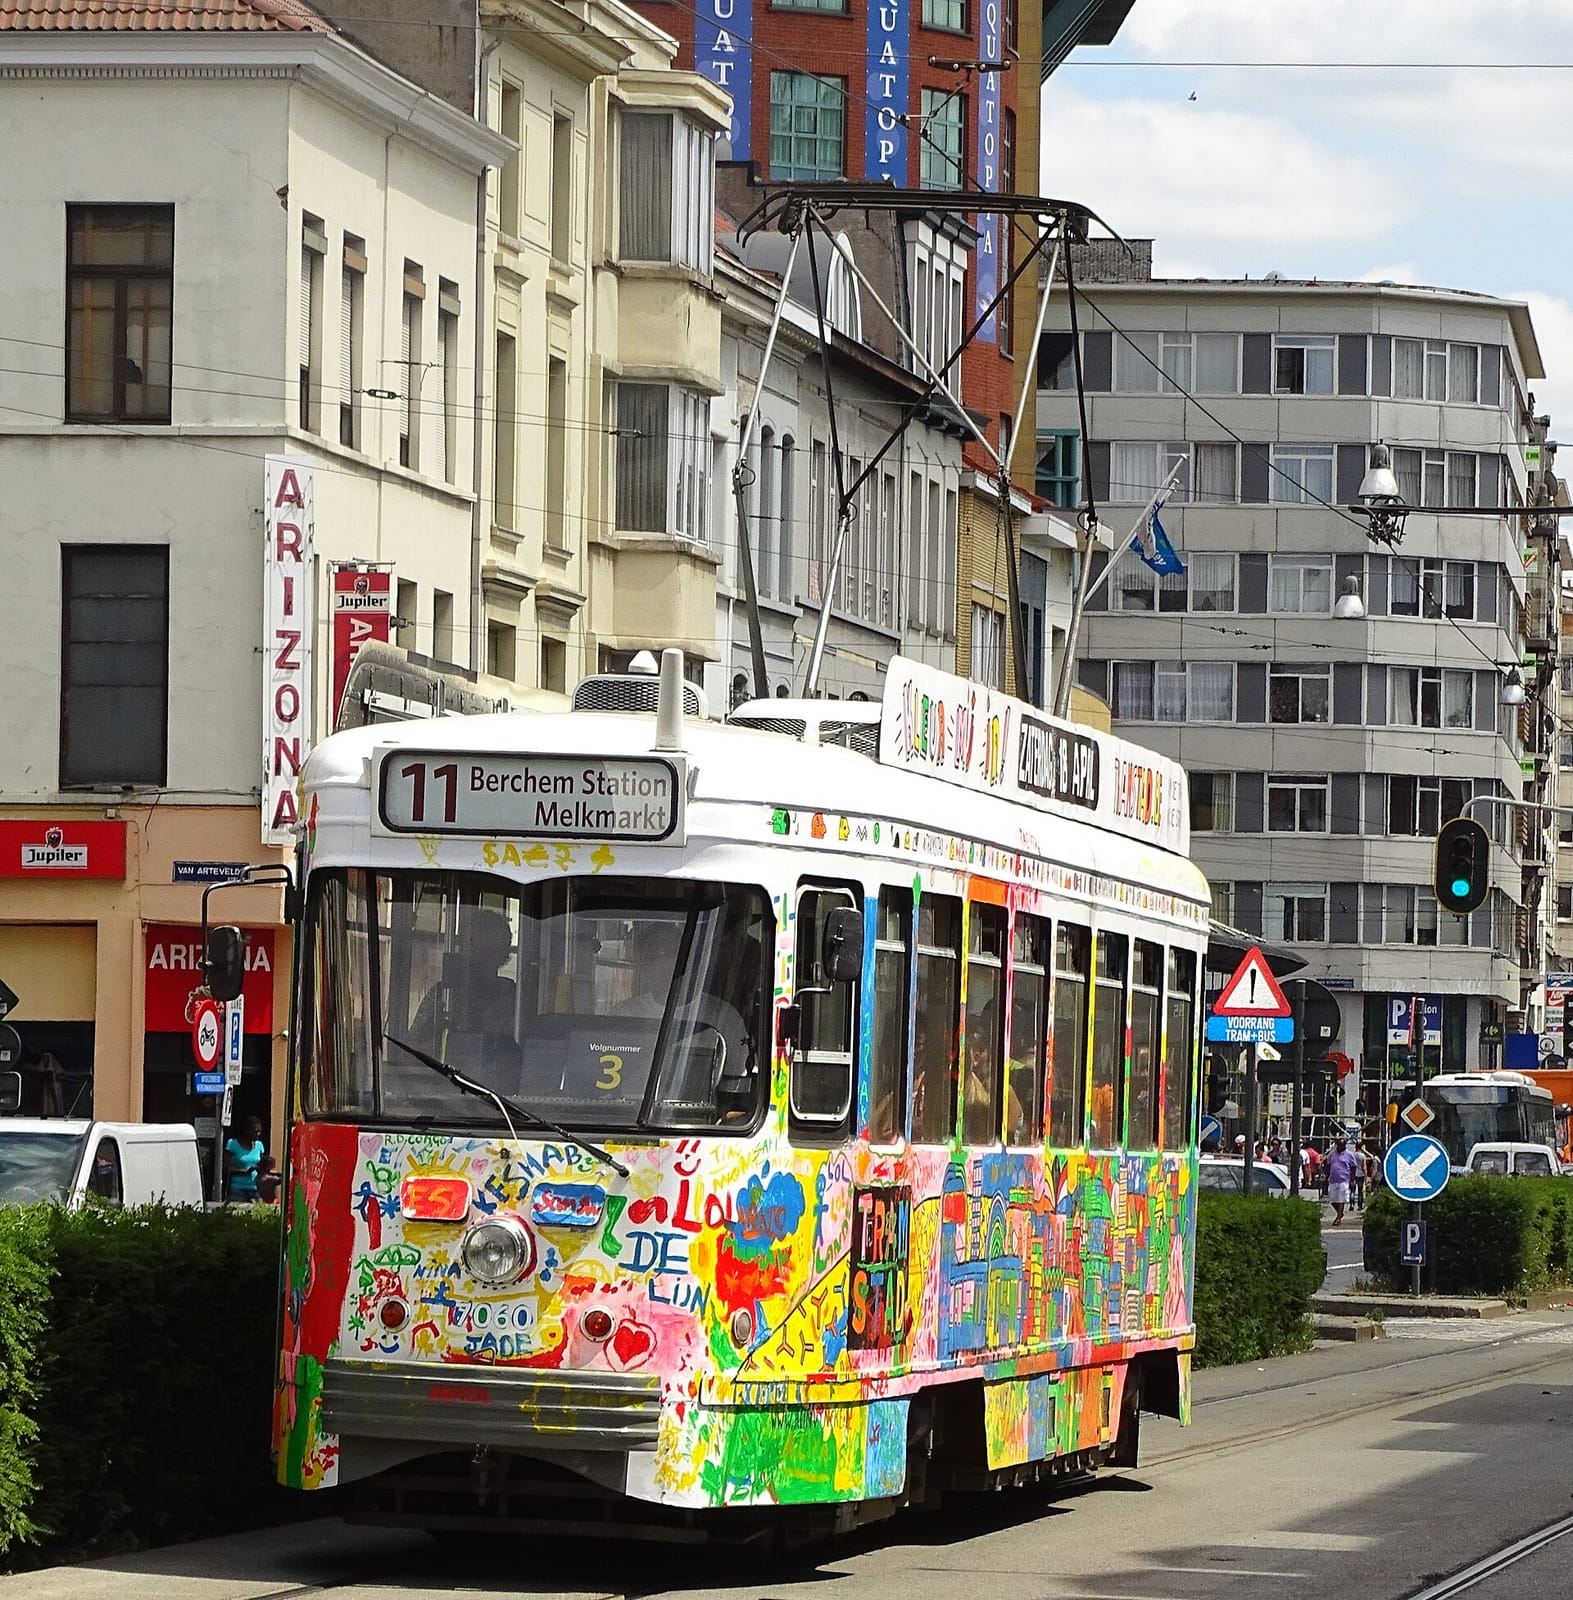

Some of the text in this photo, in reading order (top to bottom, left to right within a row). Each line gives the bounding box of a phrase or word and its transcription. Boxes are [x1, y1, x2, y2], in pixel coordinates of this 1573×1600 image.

[336, 594, 387, 609] Jupiler
[271, 468, 305, 830] ARIZONA
[401, 763, 667, 823] 11 Berchem Station
[534, 801, 667, 831] Melkmarkt
[25, 848, 83, 865] Jupiler
[178, 867, 242, 876] VAN ARTEVELD
[1227, 1016, 1275, 1029] VOORRANG
[1392, 1000, 1407, 1026] P
[589, 1042, 641, 1053] Volgnummer
[1226, 1029, 1276, 1042] TRAM+BUS
[595, 1054, 623, 1090] 3
[618, 1231, 689, 1275] DE
[1407, 1223, 1420, 1255] P
[456, 1300, 532, 1331] 7060
